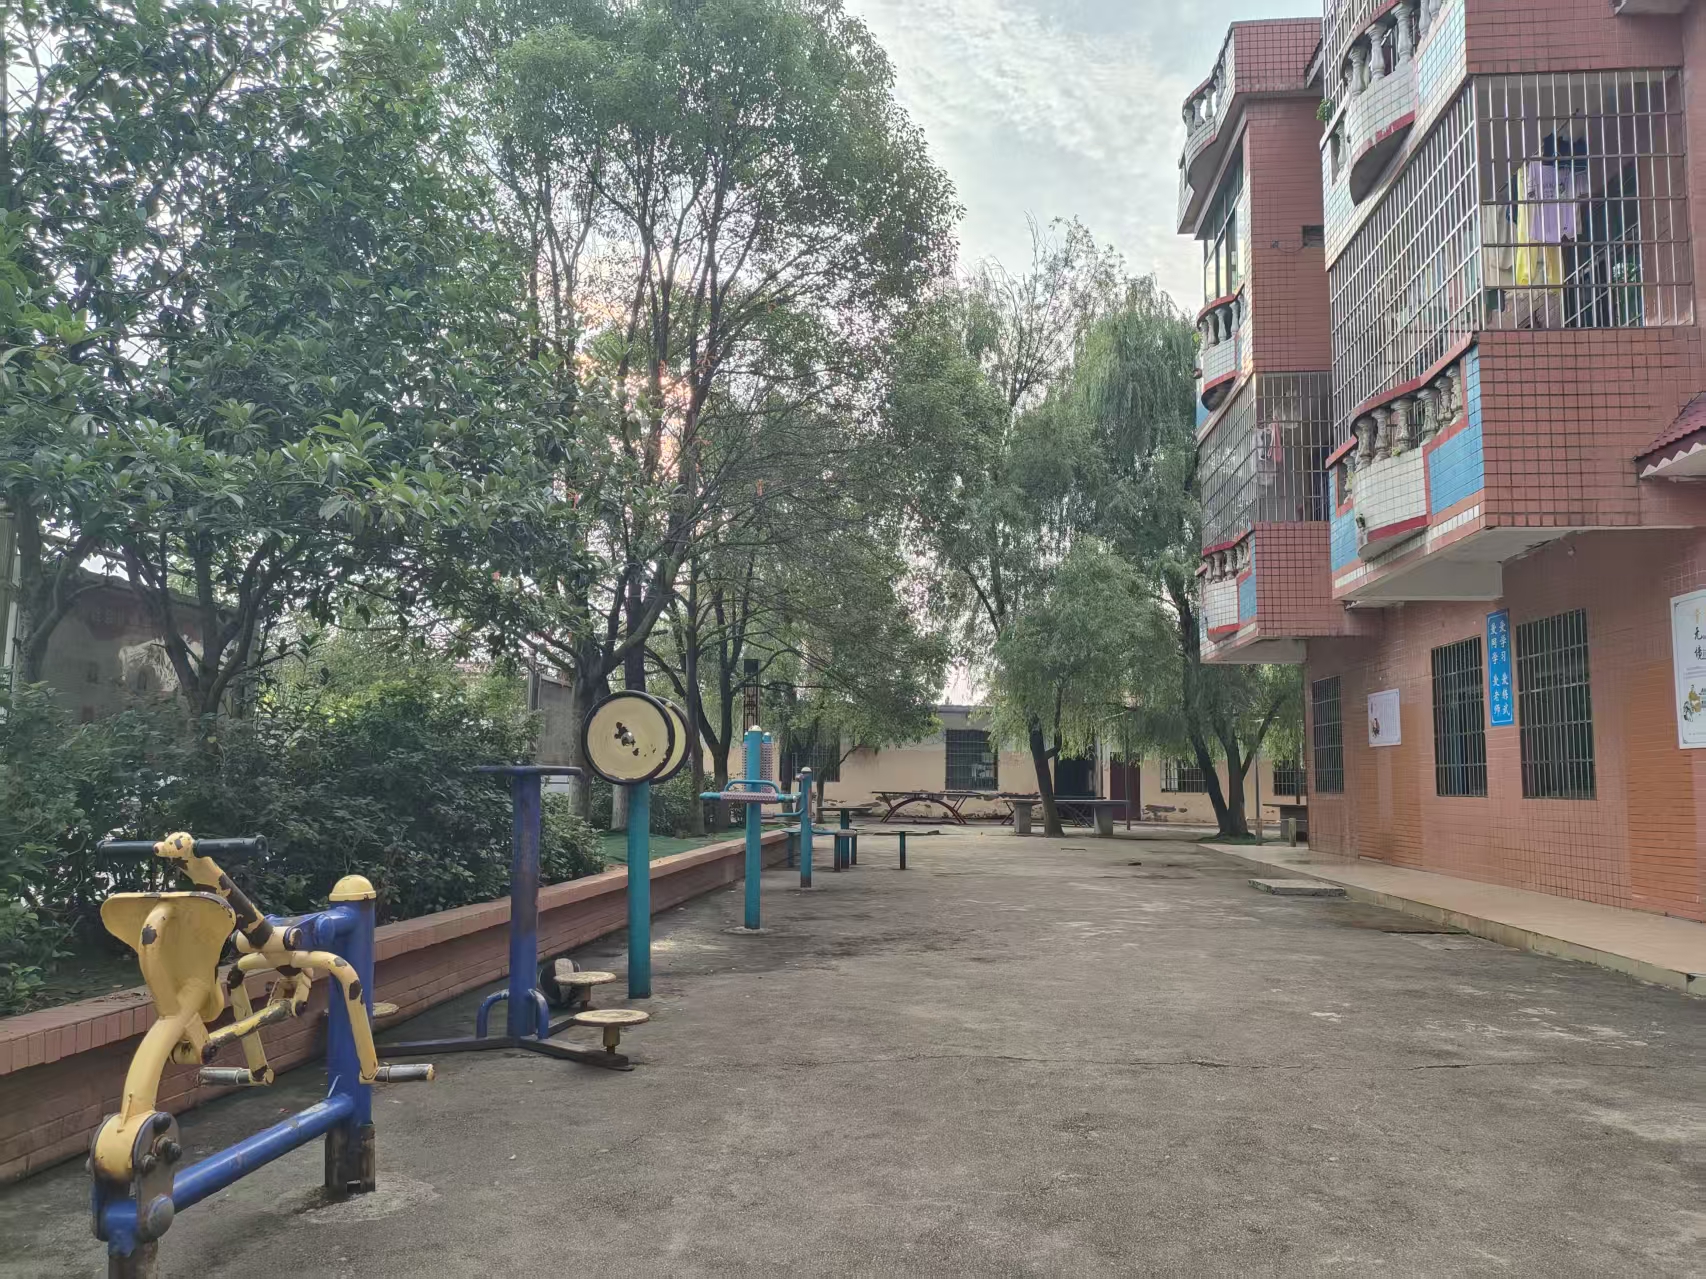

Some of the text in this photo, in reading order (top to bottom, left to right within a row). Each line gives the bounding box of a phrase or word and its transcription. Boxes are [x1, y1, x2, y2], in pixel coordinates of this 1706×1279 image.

[1490, 622, 1501, 716] 爱同学 爱老师
[1499, 620, 1507, 662] 爱学习
